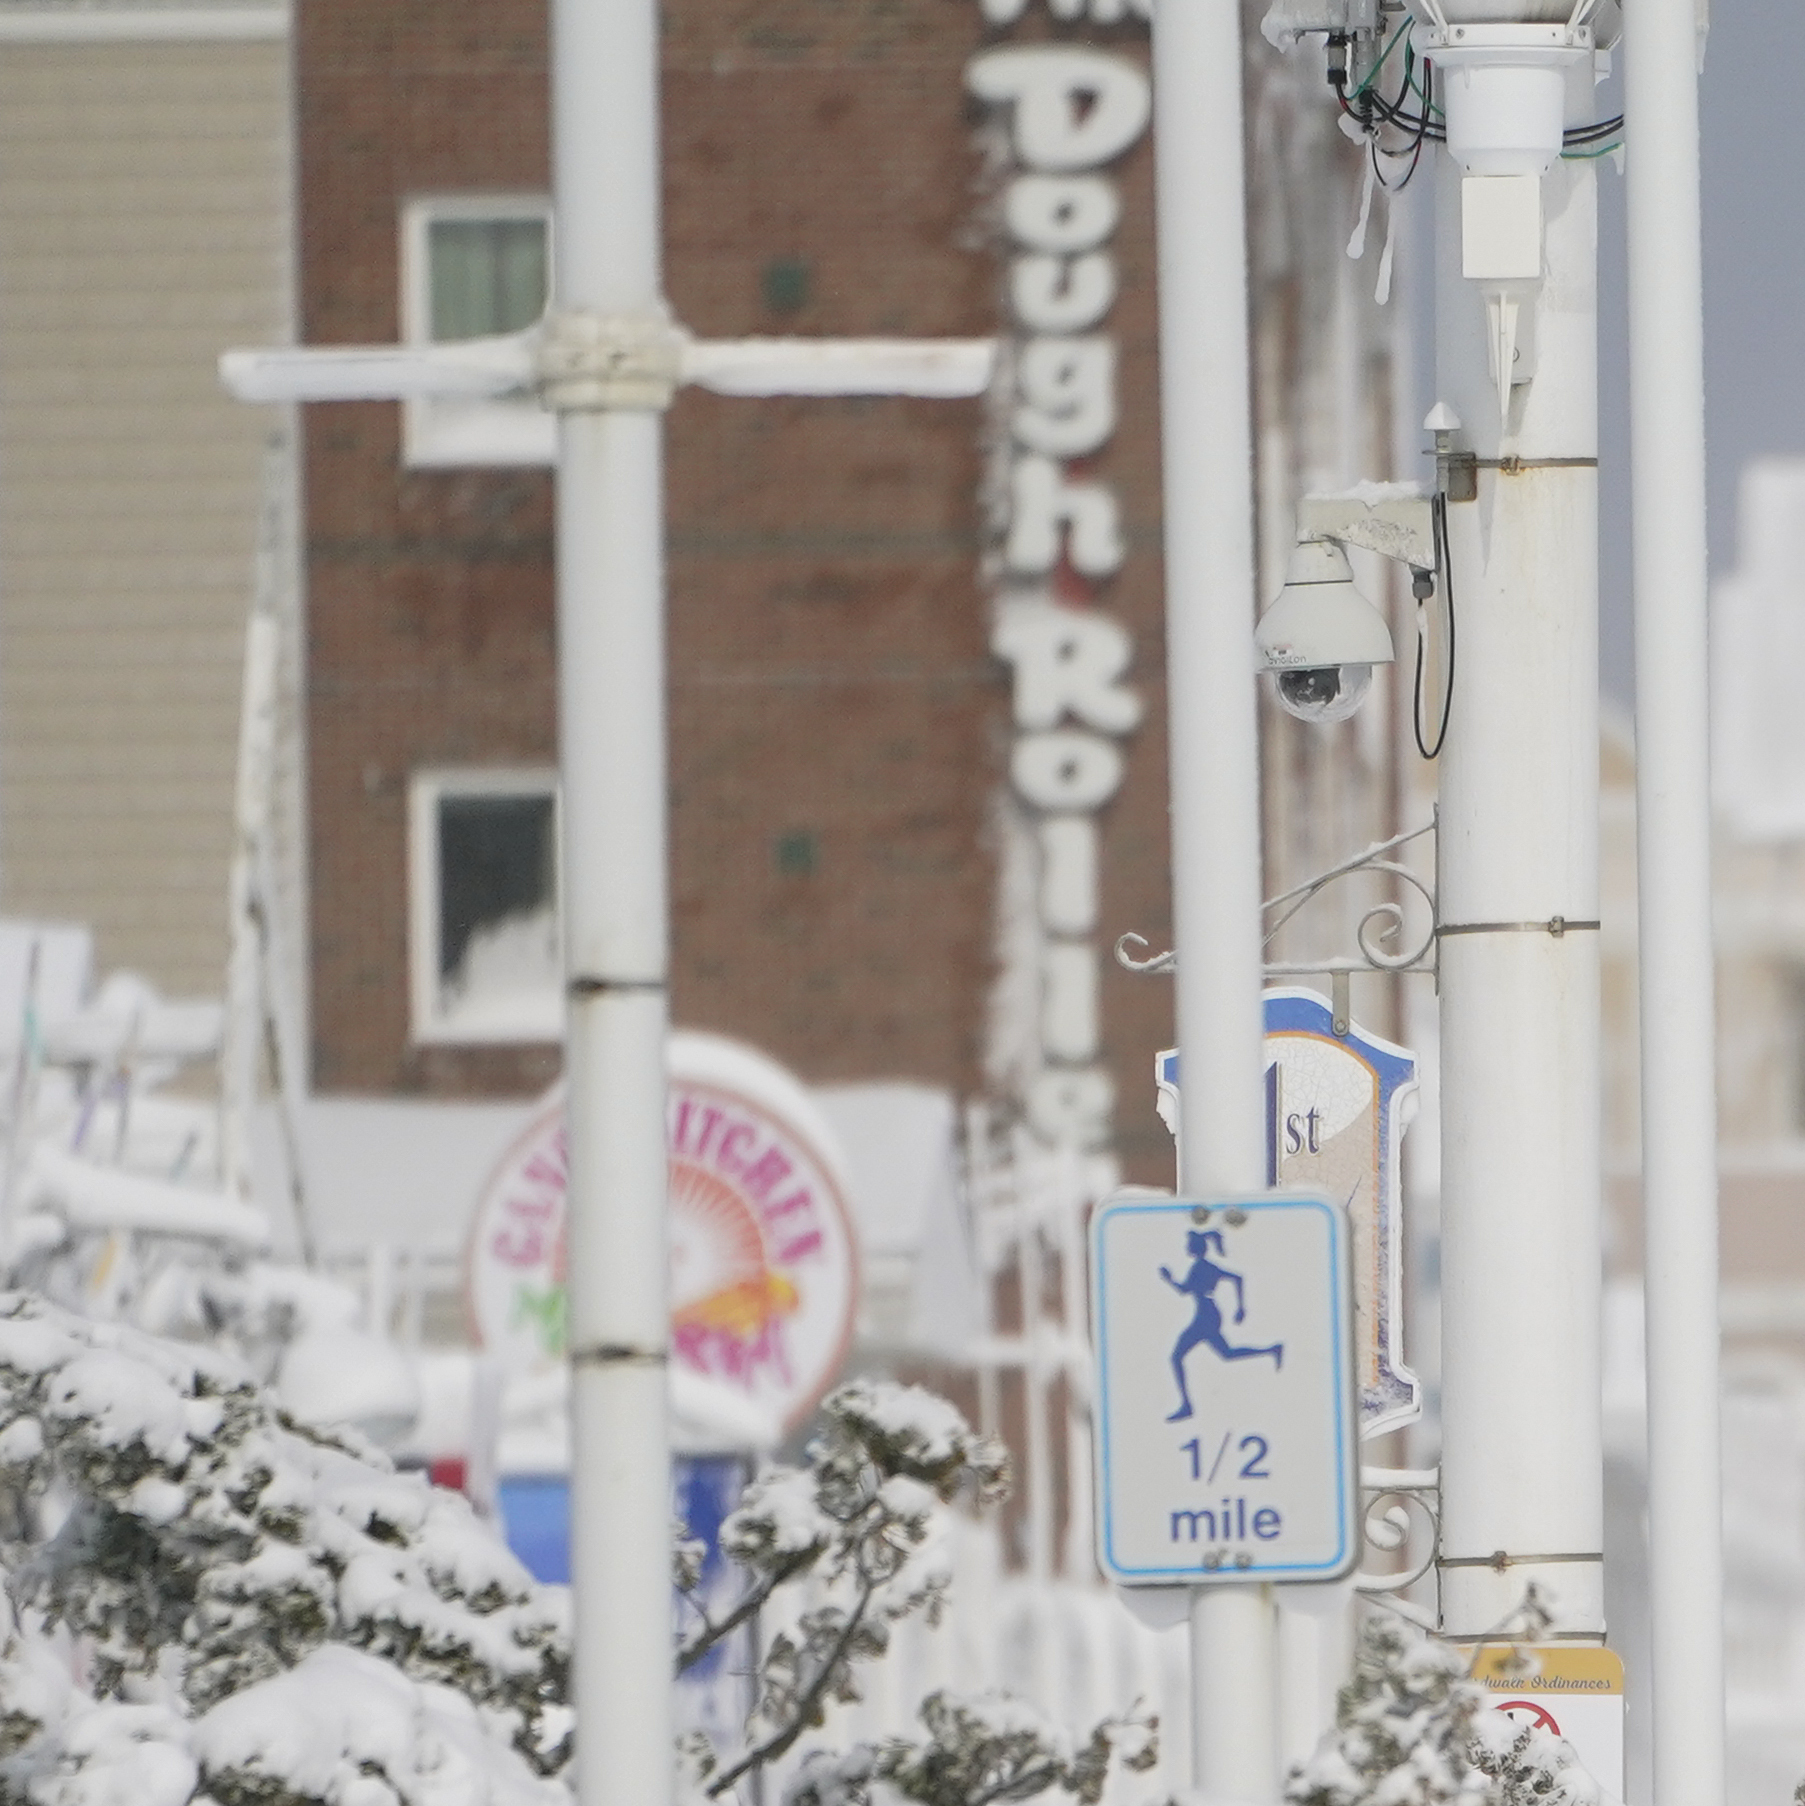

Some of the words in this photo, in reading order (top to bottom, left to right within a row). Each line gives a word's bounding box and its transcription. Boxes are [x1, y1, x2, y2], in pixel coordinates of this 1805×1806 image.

[964, 46, 1153, 572] Dough
[1179, 1432, 1270, 1486] 1/2
[1170, 1499, 1282, 1543] mile
[1530, 1674, 1611, 1690] Ordinances
